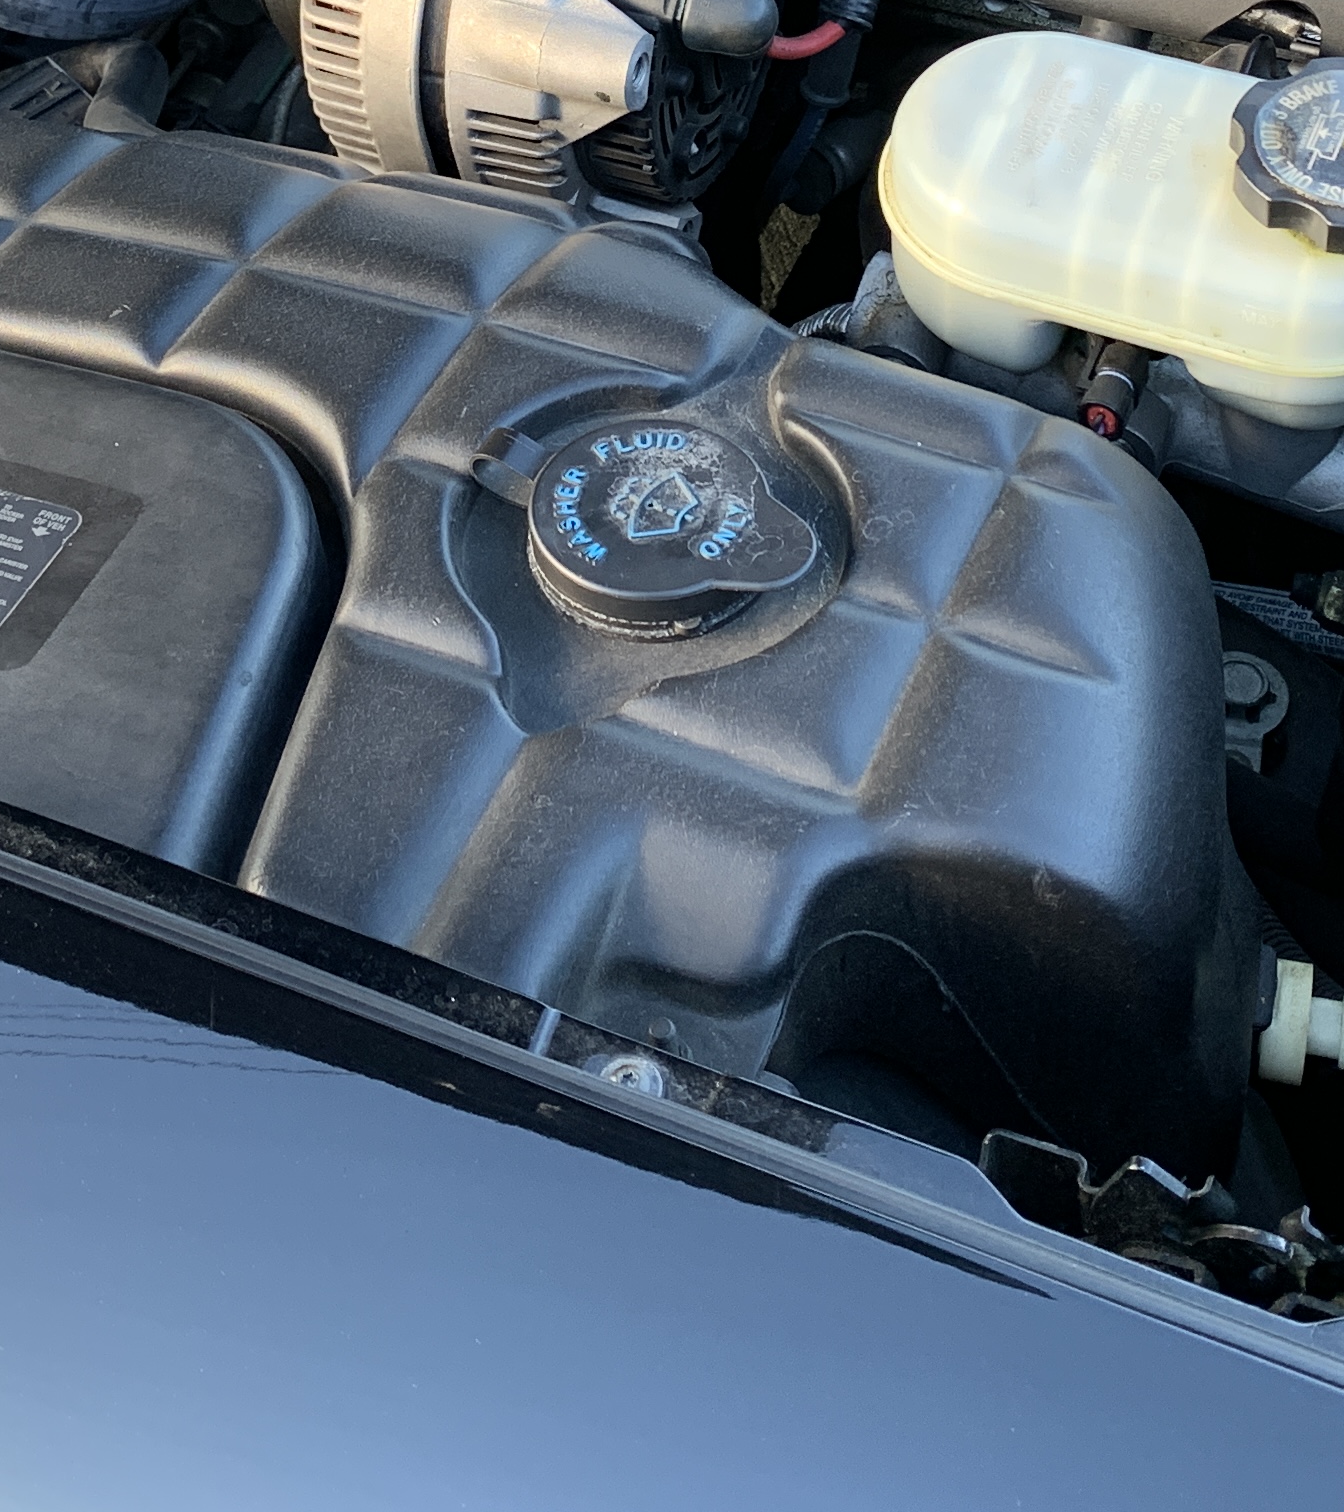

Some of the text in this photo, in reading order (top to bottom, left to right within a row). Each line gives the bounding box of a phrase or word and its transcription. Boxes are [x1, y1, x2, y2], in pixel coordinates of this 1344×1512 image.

[1278, 79, 1339, 110] BRAKE
[1267, 155, 1314, 186] ONLY
[554, 430, 747, 566] WASHER FLUID ONLY
[38, 509, 73, 524] FRONT
[33, 517, 67, 532] OF VEH
[7, 536, 24, 544] EVAP
[0, 556, 29, 570] CANISTER
[1289, 611, 1307, 620] AND
